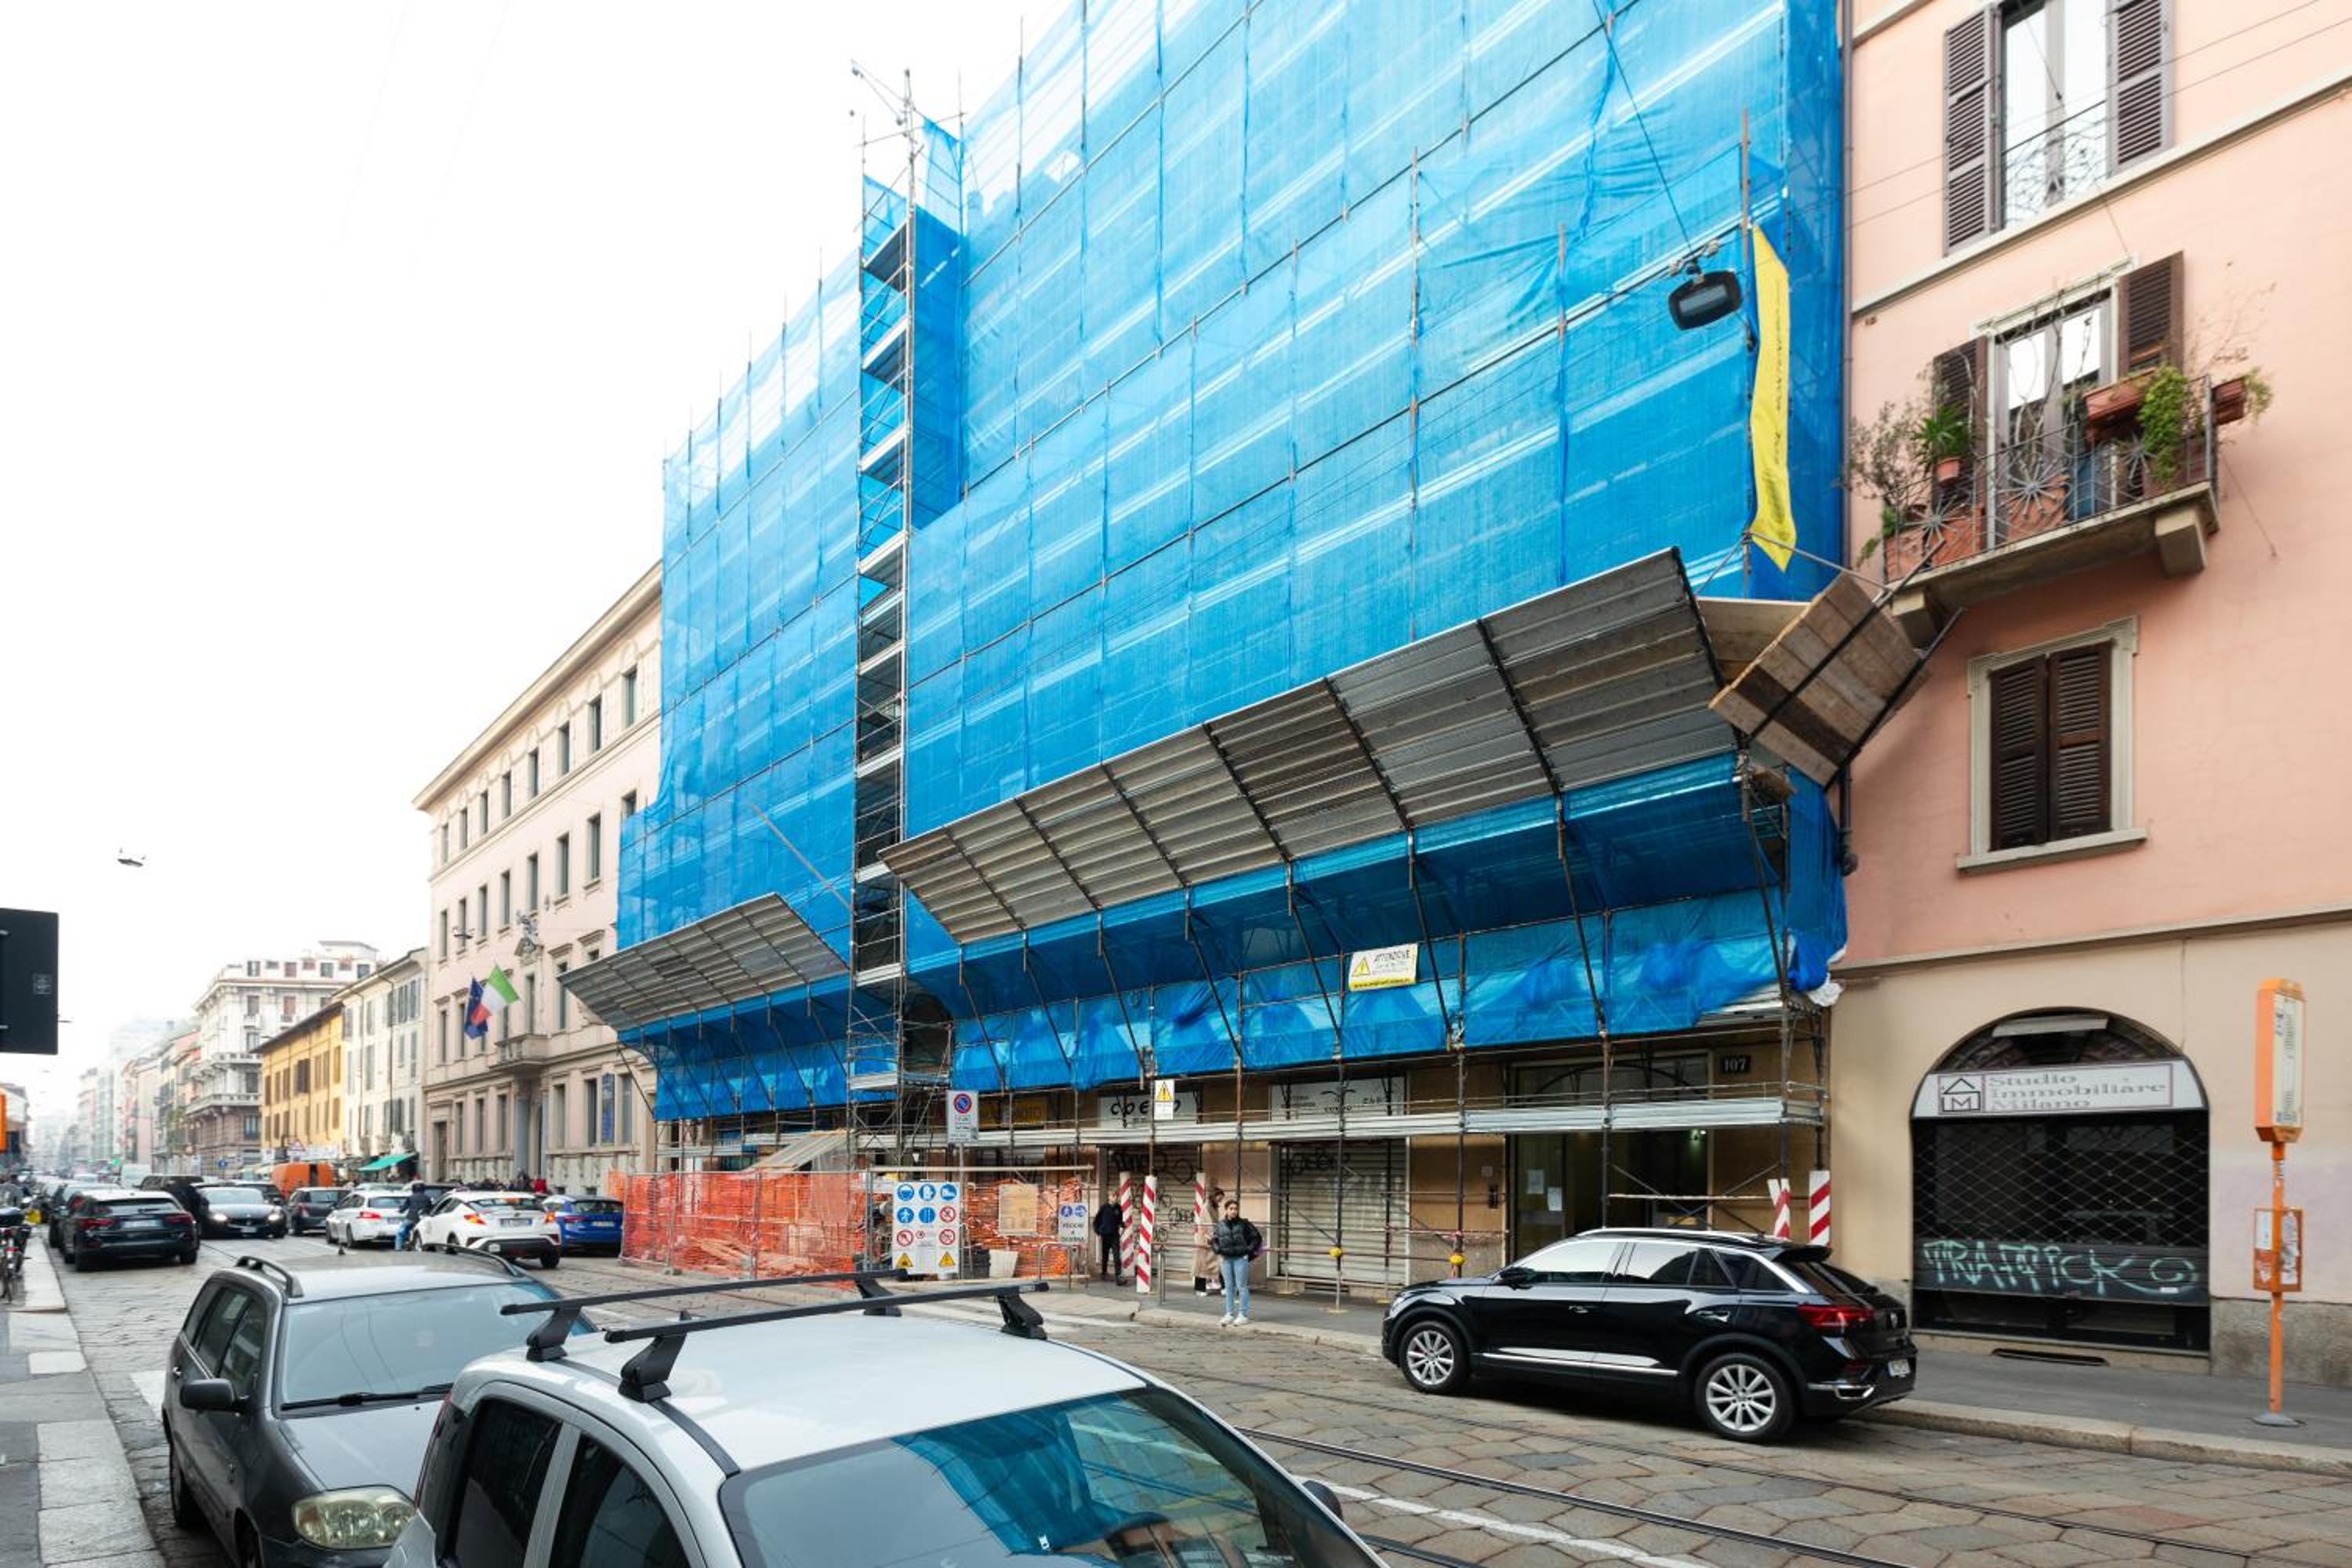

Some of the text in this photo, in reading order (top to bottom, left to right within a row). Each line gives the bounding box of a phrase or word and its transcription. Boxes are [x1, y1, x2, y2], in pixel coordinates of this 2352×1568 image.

[1725, 1058, 1746, 1071] 107
[1989, 1073, 2077, 1087] Studio
[1990, 1098, 2091, 1110] Milano
